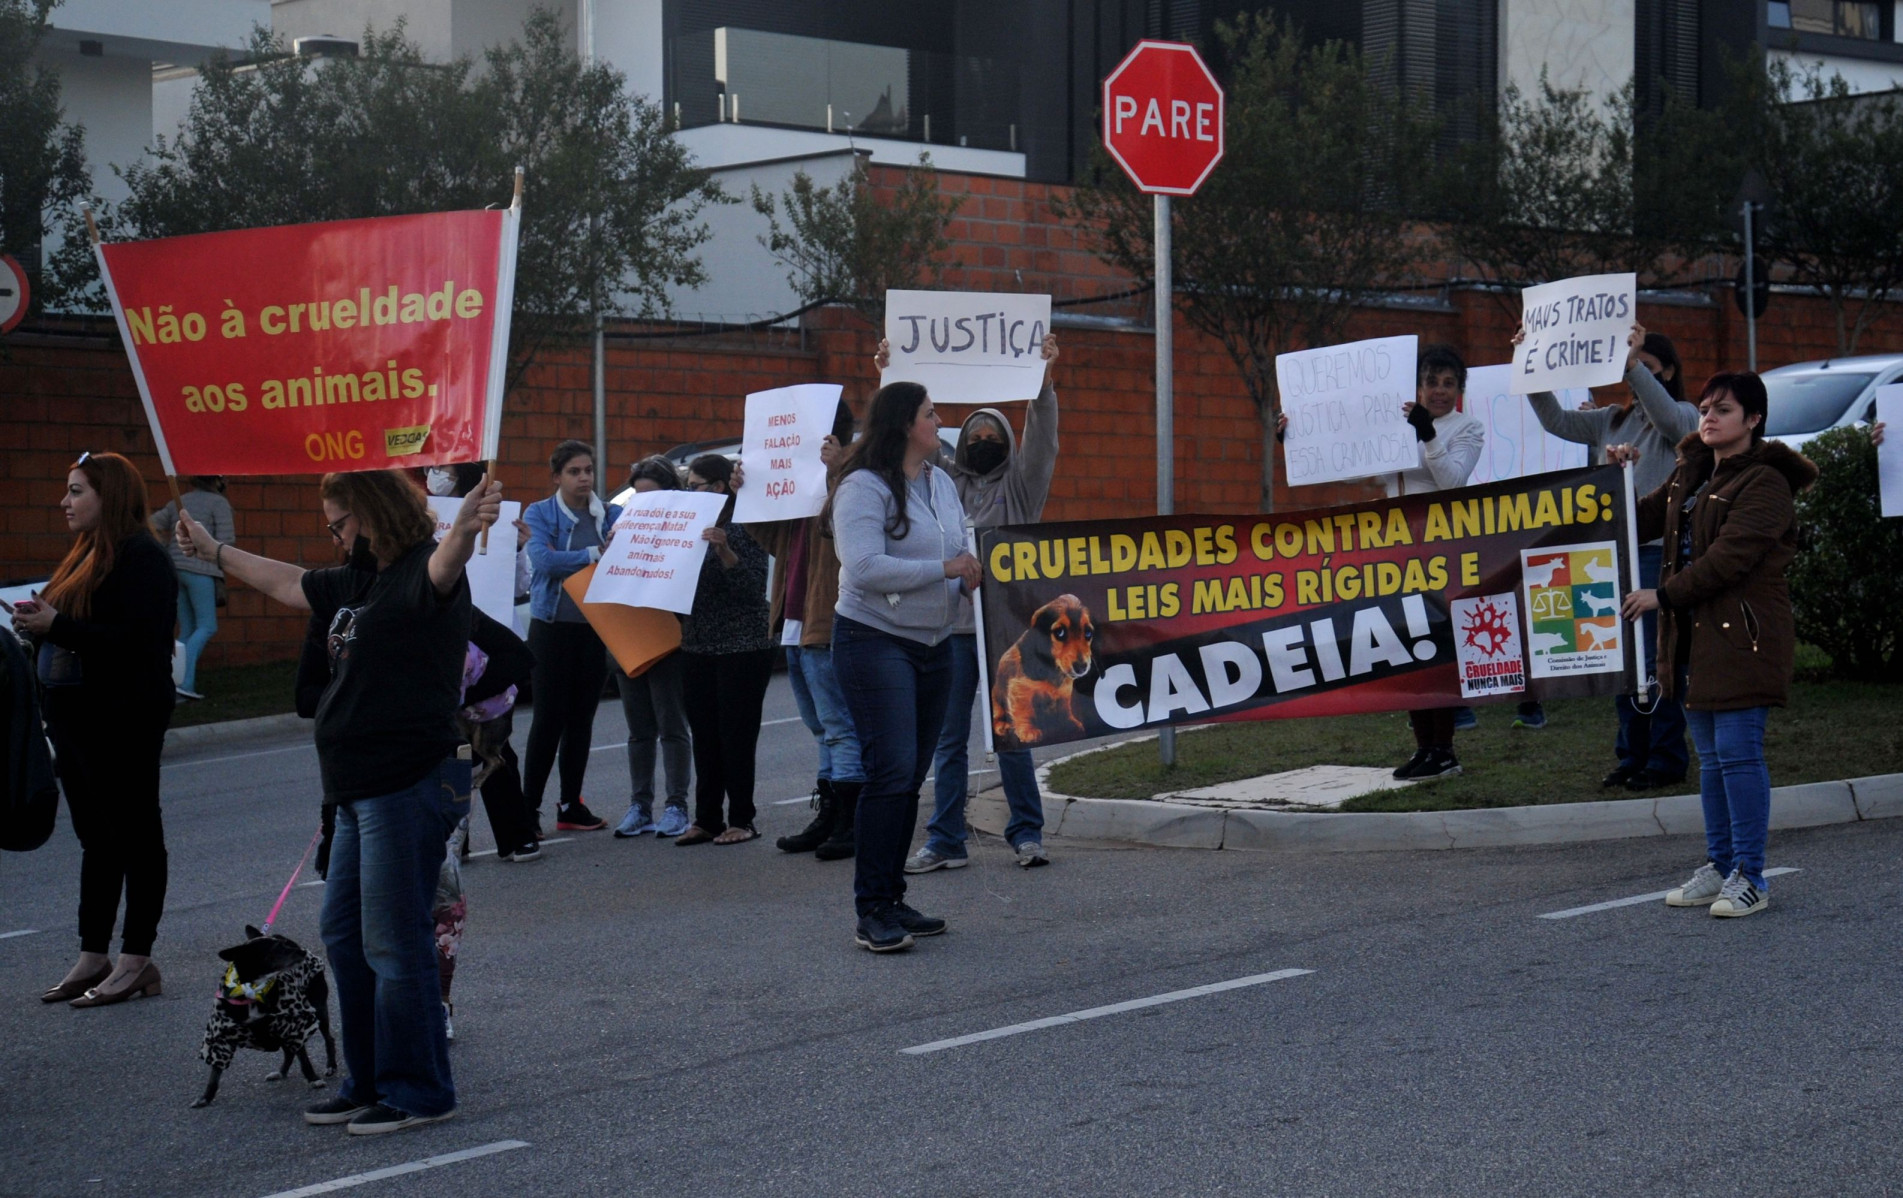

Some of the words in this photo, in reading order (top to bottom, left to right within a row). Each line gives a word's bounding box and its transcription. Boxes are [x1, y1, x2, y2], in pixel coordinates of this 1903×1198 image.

[1115, 95, 1214, 142] PARE
[125, 304, 206, 345] Não
[220, 299, 246, 340] à
[260, 281, 483, 336] crueldade
[1525, 301, 1560, 333] MAUS
[1566, 293, 1629, 324] TRATOS
[898, 311, 1046, 358] JUSTIÇA
[1284, 344, 1391, 398] QUEREMOS
[1524, 339, 1539, 375] É
[181, 383, 249, 414] aos
[261, 360, 438, 410] animais.
[768, 413, 796, 427] MENOS
[305, 429, 366, 462] ONG
[764, 434, 801, 449] FALAÇÃO
[770, 458, 792, 470] MAIS
[765, 478, 795, 500] AÇÃO
[678, 511, 697, 520] sua
[630, 534, 650, 544] Não
[681, 540, 693, 549] os
[989, 524, 1238, 583] CRUELDADES
[1249, 508, 1414, 561] CONTRA
[1423, 484, 1613, 543] ANIMAIS:
[627, 550, 665, 562] animais
[1106, 583, 1181, 621] LEIS
[1191, 573, 1285, 614] MAIS
[1296, 556, 1448, 605] RÍGIDAS
[1460, 552, 1480, 587] E
[1093, 594, 1437, 729] CADEIA!
[1465, 660, 1522, 679] CRUELDADE
[1467, 676, 1499, 691] NUNCA
[1500, 674, 1524, 687] MAIS
